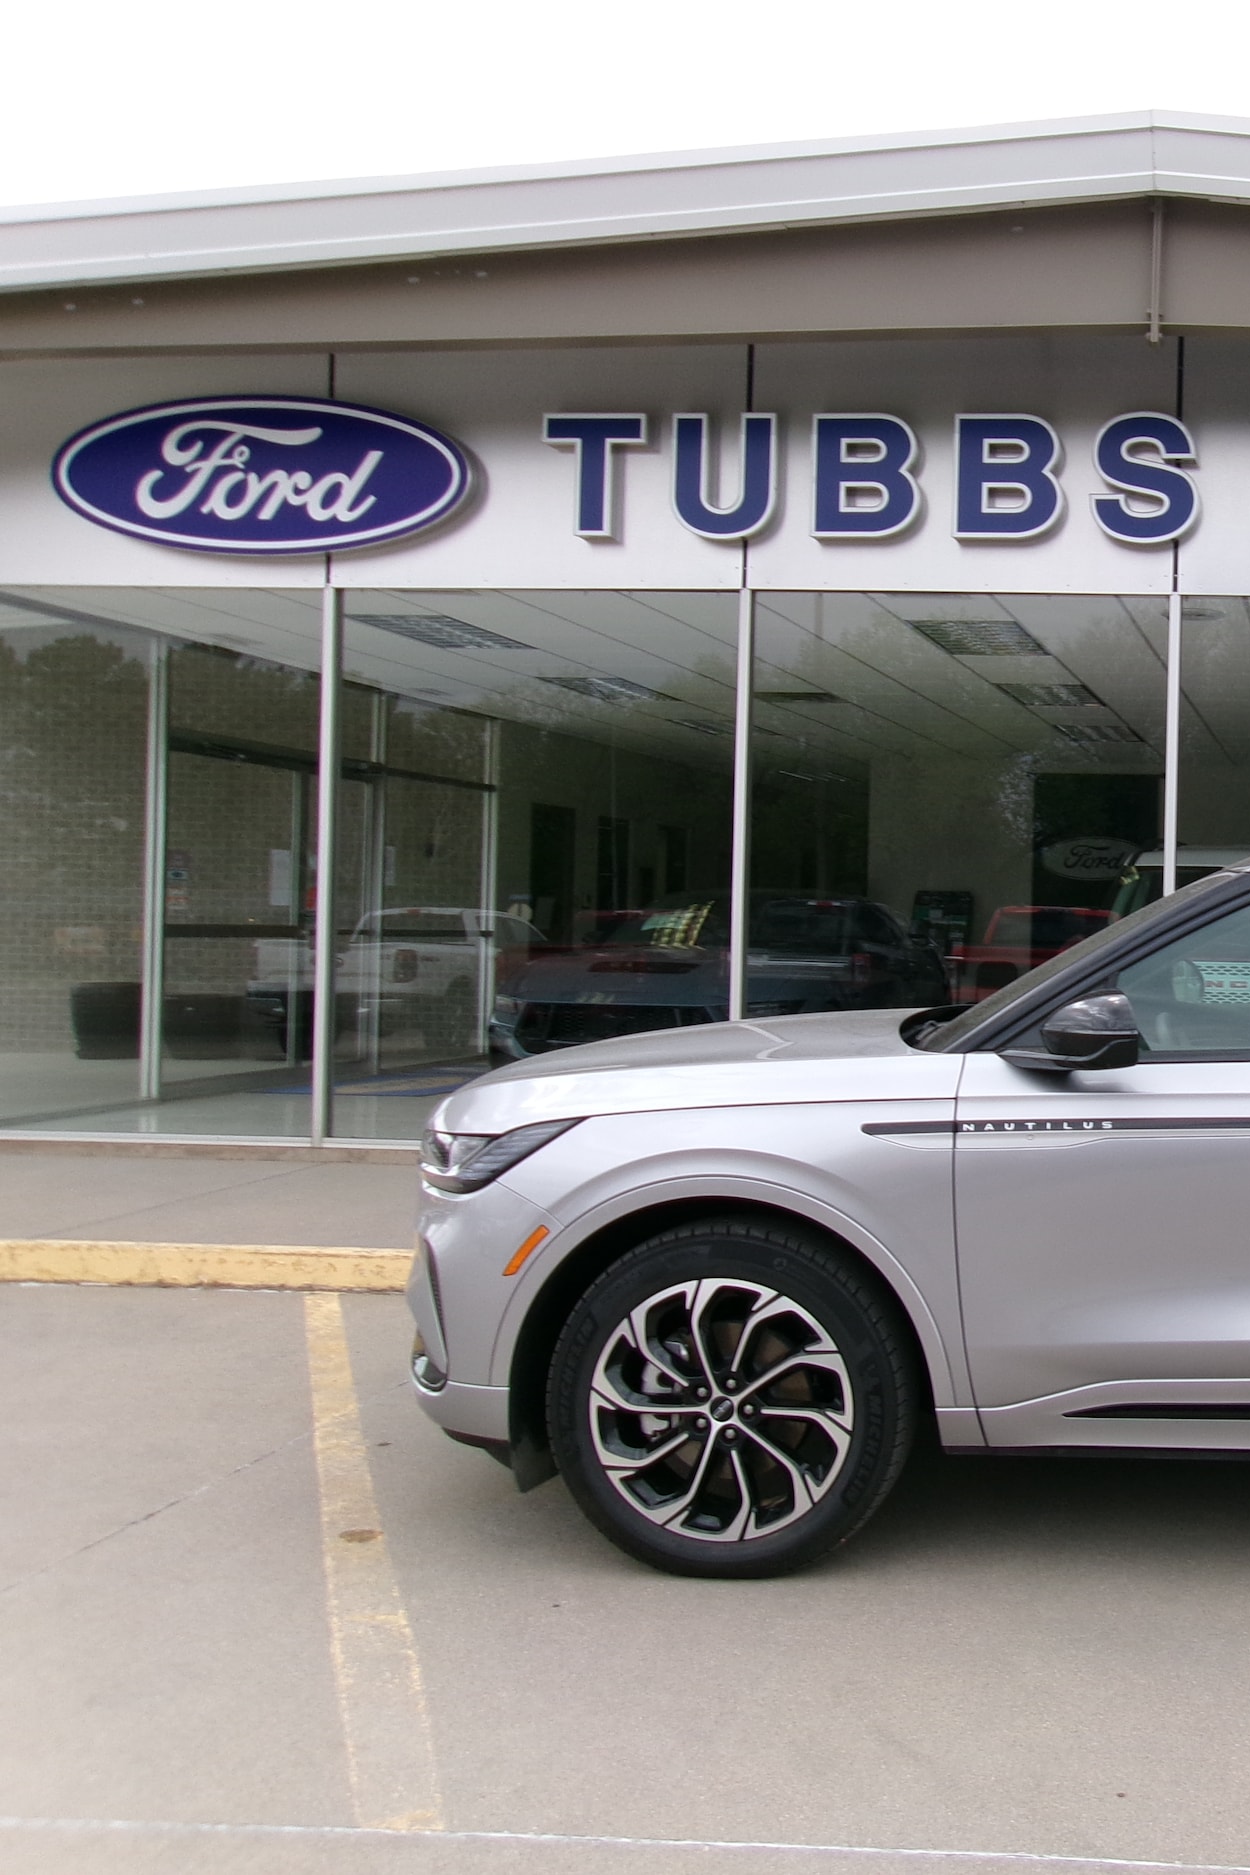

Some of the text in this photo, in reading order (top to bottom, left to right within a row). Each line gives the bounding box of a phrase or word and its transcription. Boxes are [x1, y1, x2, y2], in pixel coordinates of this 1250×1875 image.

[136, 421, 384, 522] Ford
[541, 411, 1202, 544] TUBBS
[1064, 844, 1126, 869] Ford
[962, 1120, 1114, 1132] NAUTILUS
